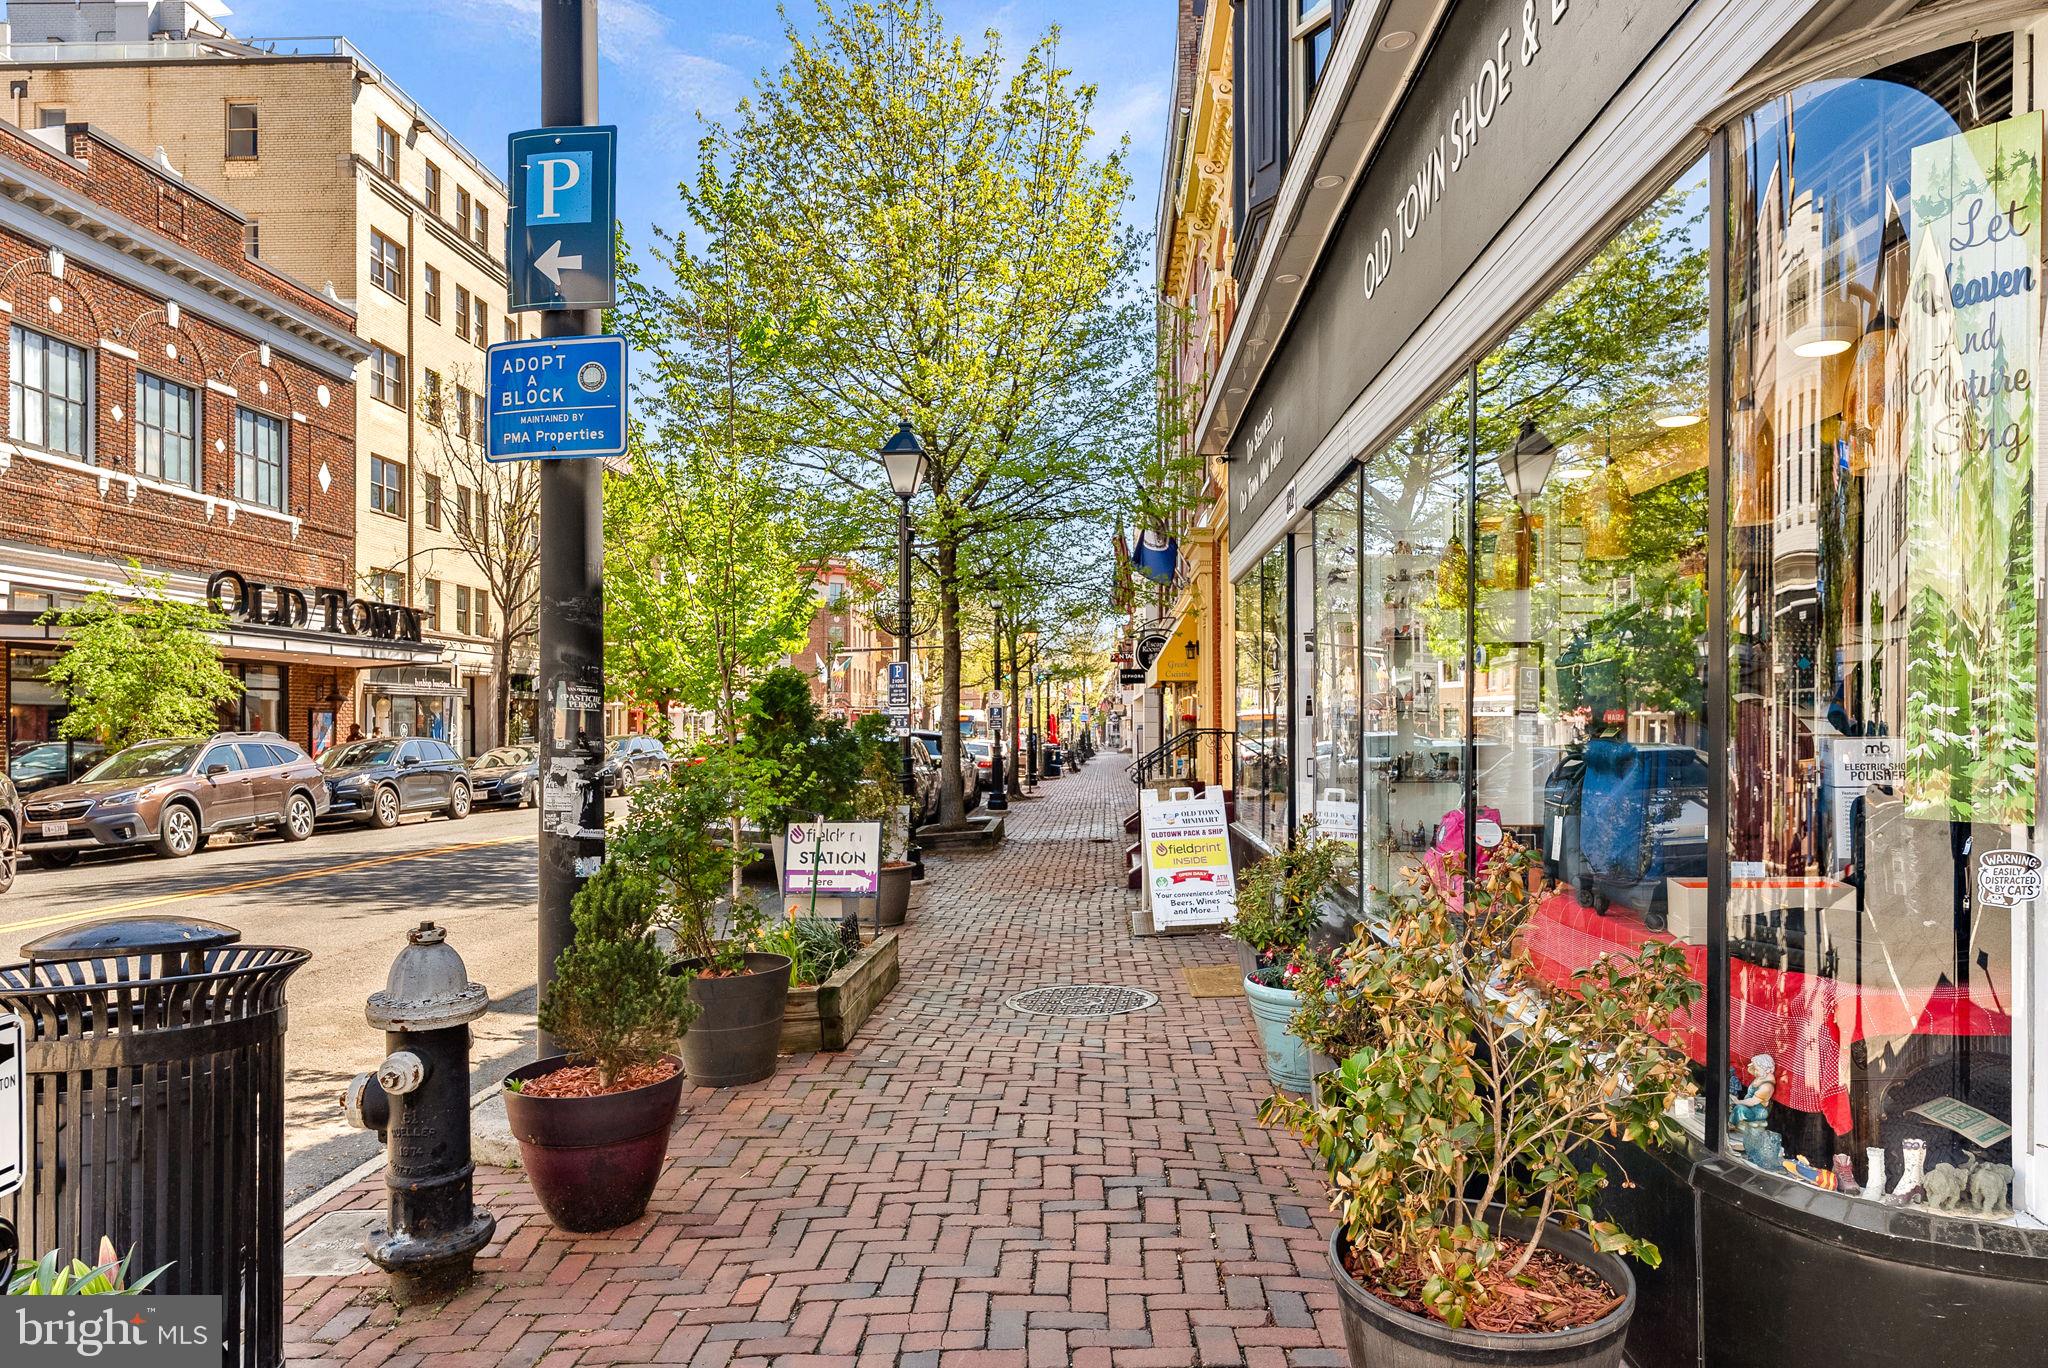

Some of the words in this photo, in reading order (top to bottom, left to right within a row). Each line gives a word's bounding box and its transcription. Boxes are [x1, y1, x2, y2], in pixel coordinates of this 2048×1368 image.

[1364, 227, 1392, 299] OLD
[1396, 135, 1446, 253] TOWN
[1451, 27, 1512, 172] SHOE
[1521, 0, 1541, 67] &
[537, 158, 581, 219] P
[1950, 198, 2031, 251] Let
[502, 354, 566, 374] ADOPT
[527, 375, 537, 386] A
[502, 388, 564, 406] BLOCK
[520, 414, 568, 424] MAINTAINED
[572, 413, 584, 421] BY
[503, 431, 530, 444] PMA
[536, 428, 604, 443] Properties
[206, 570, 308, 630] OLD
[313, 586, 424, 642] TOWN
[895, 665, 902, 678] P
[1865, 742, 1890, 754] mb
[1888, 762, 1906, 770] SHO
[1850, 771, 1906, 781] POLISHER
[1168, 842, 1222, 854] fieldprint
[800, 852, 866, 864] STATION
[1173, 856, 1208, 864] INSIDE
[1985, 854, 2040, 868] WARNING:
[1993, 868, 2022, 876] EASILY
[2008, 886, 2034, 895] CATS
[0, 1074, 16, 1090] TON
